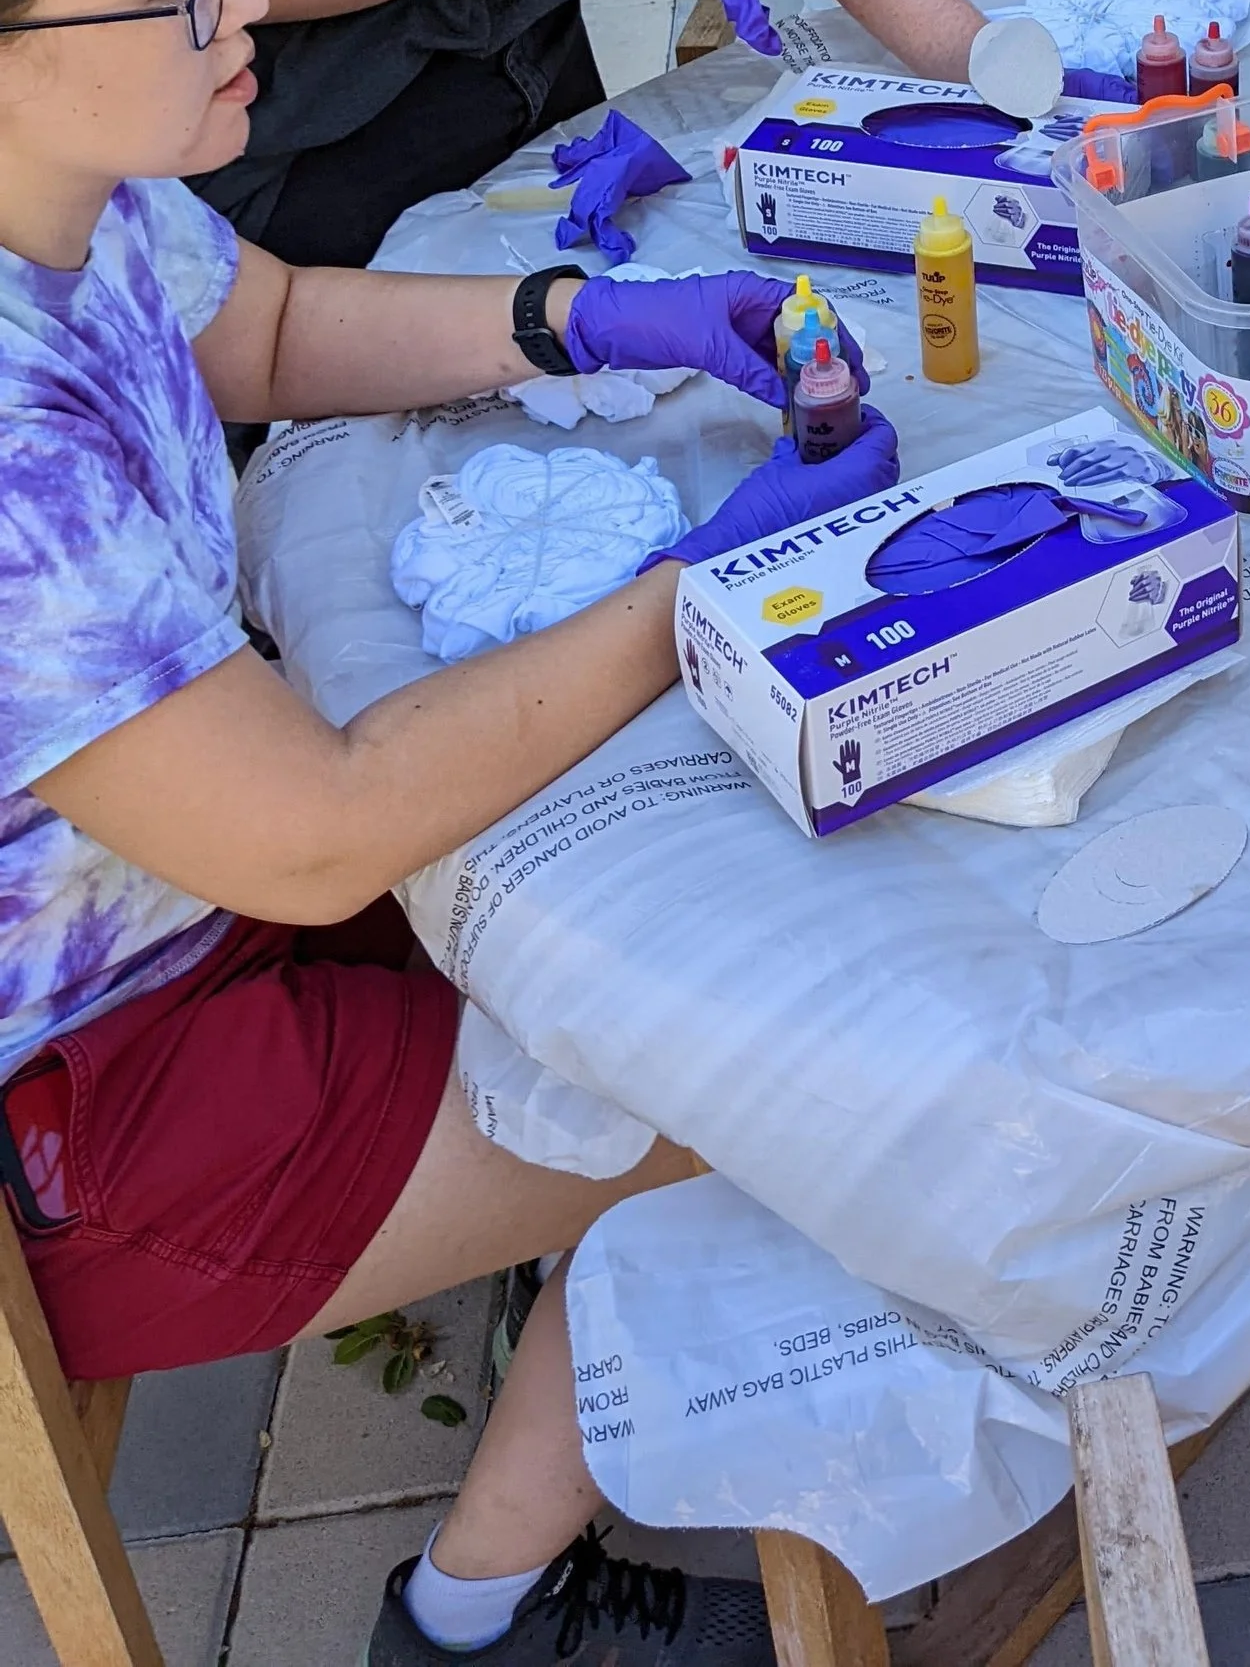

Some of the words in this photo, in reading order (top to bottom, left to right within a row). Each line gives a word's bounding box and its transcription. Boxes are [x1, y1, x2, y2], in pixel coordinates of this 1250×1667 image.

[799, 106, 828, 115] Gloves
[806, 101, 829, 109] Exam
[781, 138, 791, 147] S
[810, 138, 844, 152] 100
[762, 225, 778, 236] 100
[1031, 250, 1057, 261] Purple
[1037, 242, 1051, 251] The
[922, 271, 946, 283] TULIP
[1210, 391, 1232, 422] 36
[725, 570, 766, 591] Purple
[771, 592, 805, 611] Exam
[777, 599, 817, 620] Gloves
[1179, 606, 1195, 617] The
[1196, 588, 1228, 609] Original
[1172, 614, 1200, 632] Purple
[834, 654, 851, 667] M
[866, 620, 916, 650] 100
[770, 684, 798, 723] 55082
[830, 719, 872, 740] Powder-Free
[872, 710, 890, 723] Exam
[891, 701, 913, 714] Gloves
[830, 715, 860, 733] Purple
[630, 751, 732, 775] CARRIAGES
[845, 759, 856, 773] M
[598, 772, 626, 789] OR
[622, 776, 686, 795] BABIES
[660, 780, 752, 802] WARNING:
[841, 780, 862, 799] 100
[581, 791, 618, 815] AND
[631, 796, 659, 811] TO
[575, 805, 627, 841] AVOID
[490, 812, 578, 874] CHILDREN.
[502, 837, 572, 894] DANGER
[455, 874, 473, 904] BAG
[471, 874, 490, 902] DO
[488, 892, 502, 918] OF
[1147, 1197, 1177, 1260] FROM
[1161, 1207, 1205, 1309] WARNING:
[1120, 1264, 1159, 1334] BABIES
[838, 1311, 901, 1338] CRIBS,
[773, 1327, 831, 1357] BEDS,
[874, 1332, 919, 1359] THIS
[1100, 1327, 1129, 1360] AND
[577, 1354, 622, 1383] CARR
[789, 1346, 868, 1386] PLASTIC
[742, 1372, 784, 1398] BAG
[579, 1384, 629, 1414] FROM
[685, 1385, 738, 1418] AWAY
